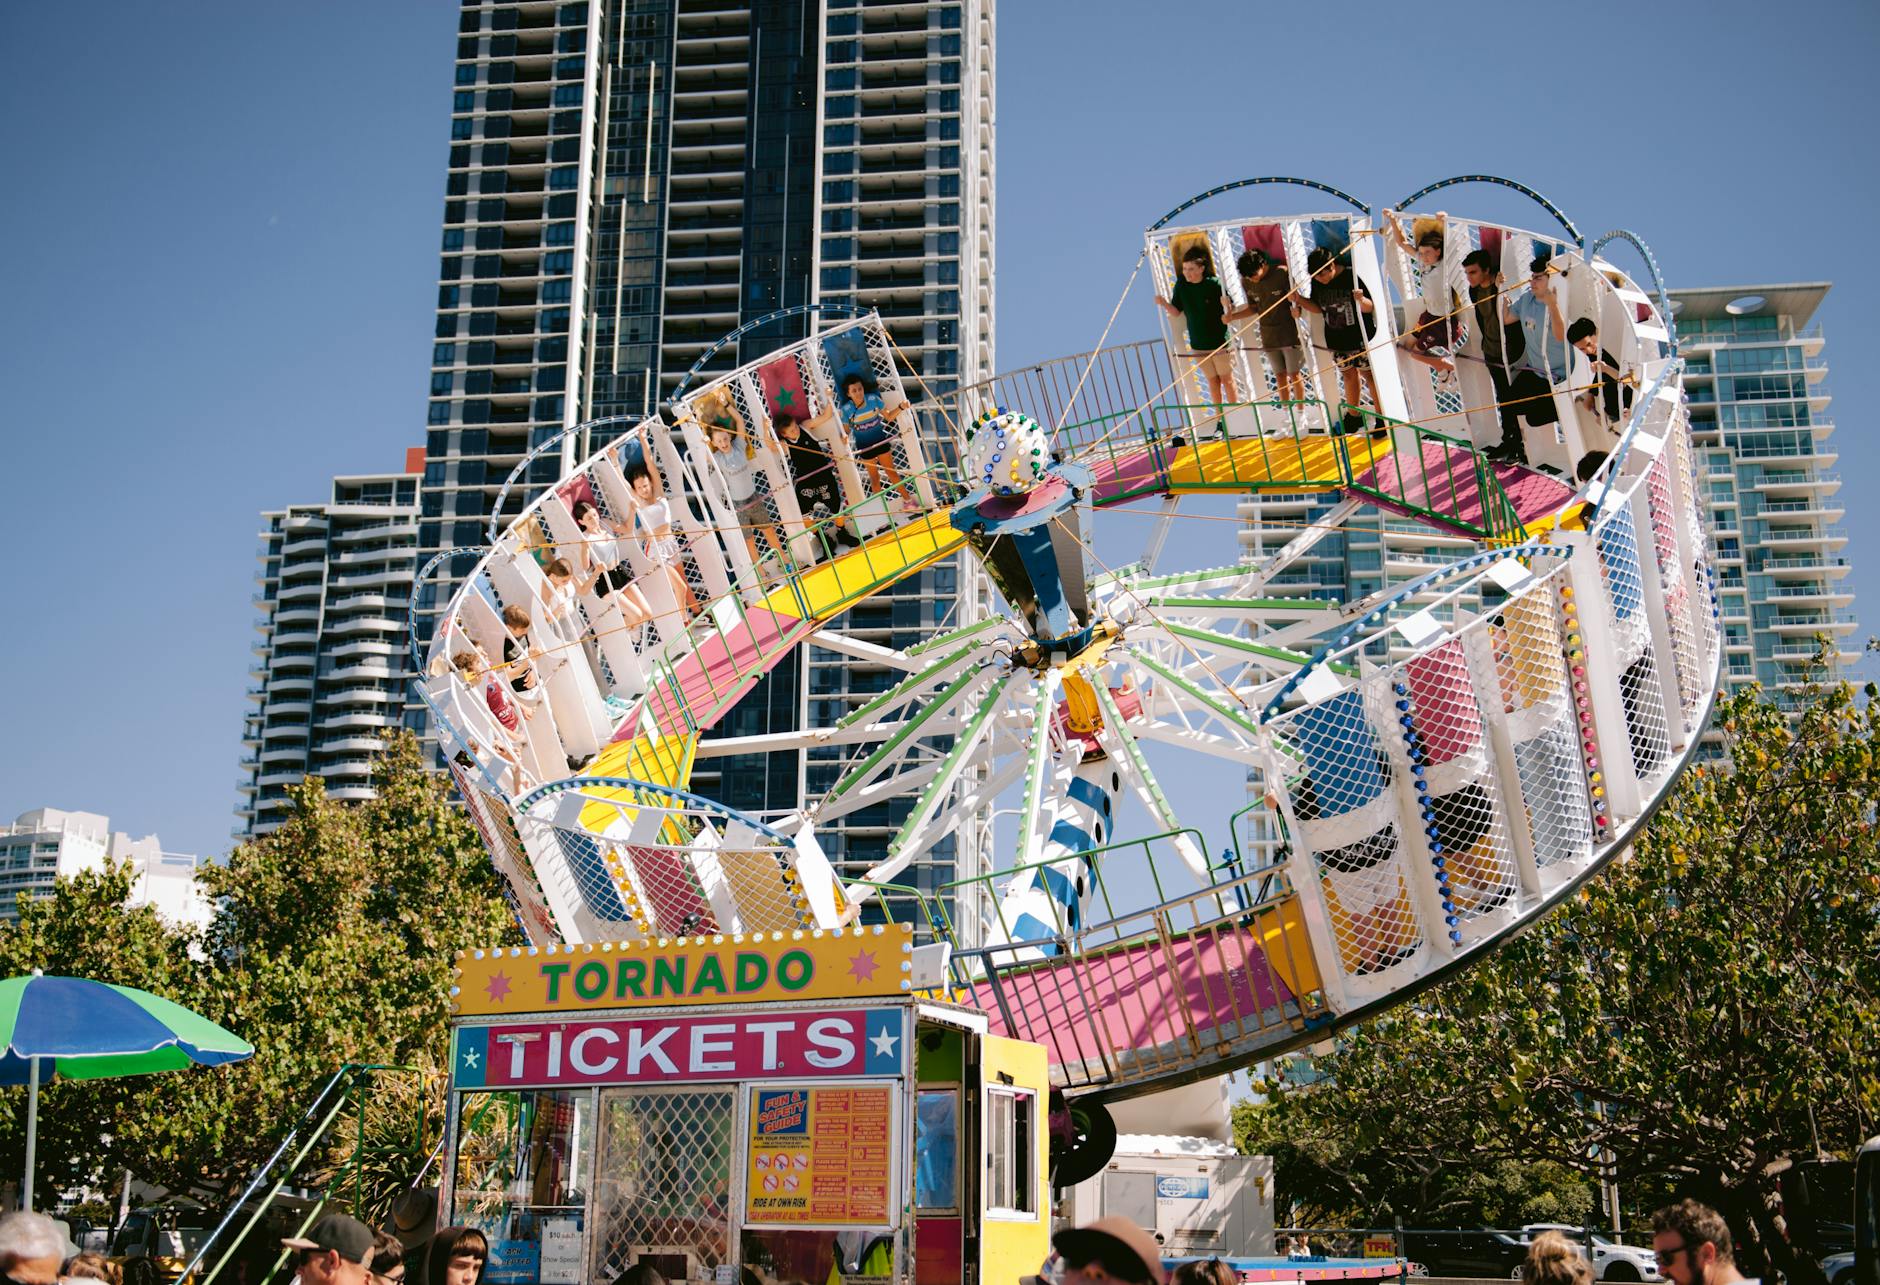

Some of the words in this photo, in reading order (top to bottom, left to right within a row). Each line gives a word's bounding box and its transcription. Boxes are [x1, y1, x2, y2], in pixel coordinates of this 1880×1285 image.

[538, 946, 816, 1004] TORNADO
[496, 1018, 856, 1079] TICKETS
[765, 1093, 790, 1111] FUN
[791, 1090, 801, 1103] &
[759, 1100, 806, 1124] SAFETY
[764, 1113, 801, 1134] GUIDE
[753, 1198, 768, 1207] RIDE
[768, 1198, 777, 1207] AT
[777, 1198, 793, 1207] OWN
[792, 1198, 807, 1207] RISK
[549, 1231, 560, 1239] $10
[560, 1256, 579, 1264] Special
